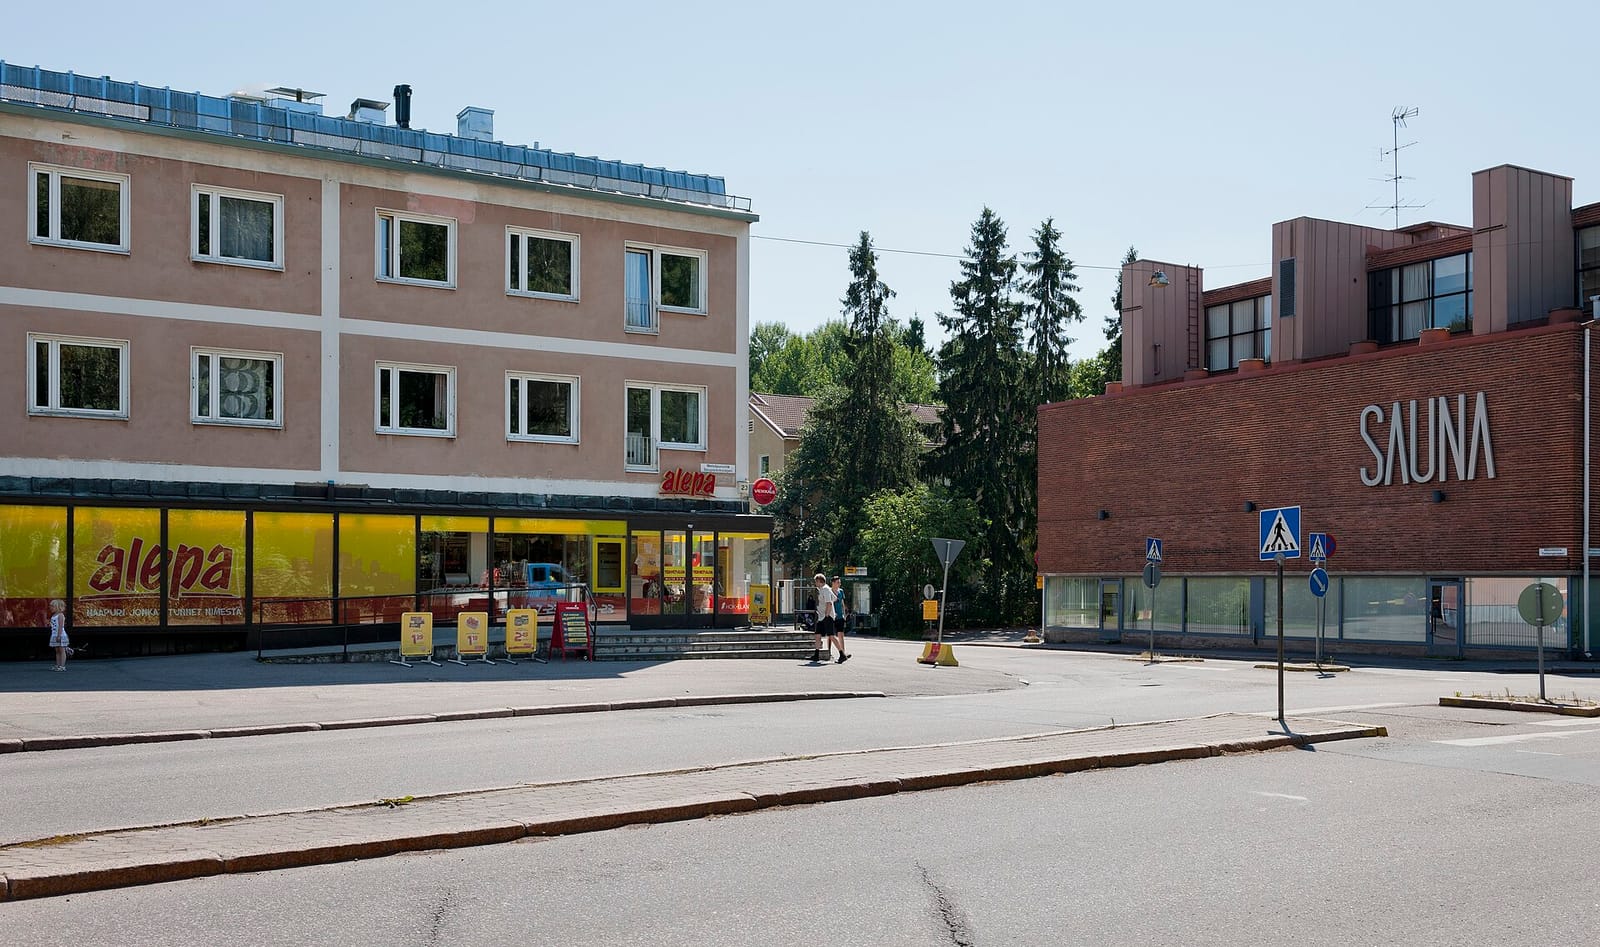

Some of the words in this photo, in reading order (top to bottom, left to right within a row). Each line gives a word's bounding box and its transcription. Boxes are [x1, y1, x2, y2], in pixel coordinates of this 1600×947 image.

[1360, 391, 1495, 486] SAUNA
[661, 468, 716, 497] alepa
[88, 537, 234, 600] alepa
[86, 608, 126, 617] NAAPURI
[129, 608, 160, 617] JONKA
[168, 607, 202, 617] TUNNET
[205, 606, 242, 617] NIMESTÄ
